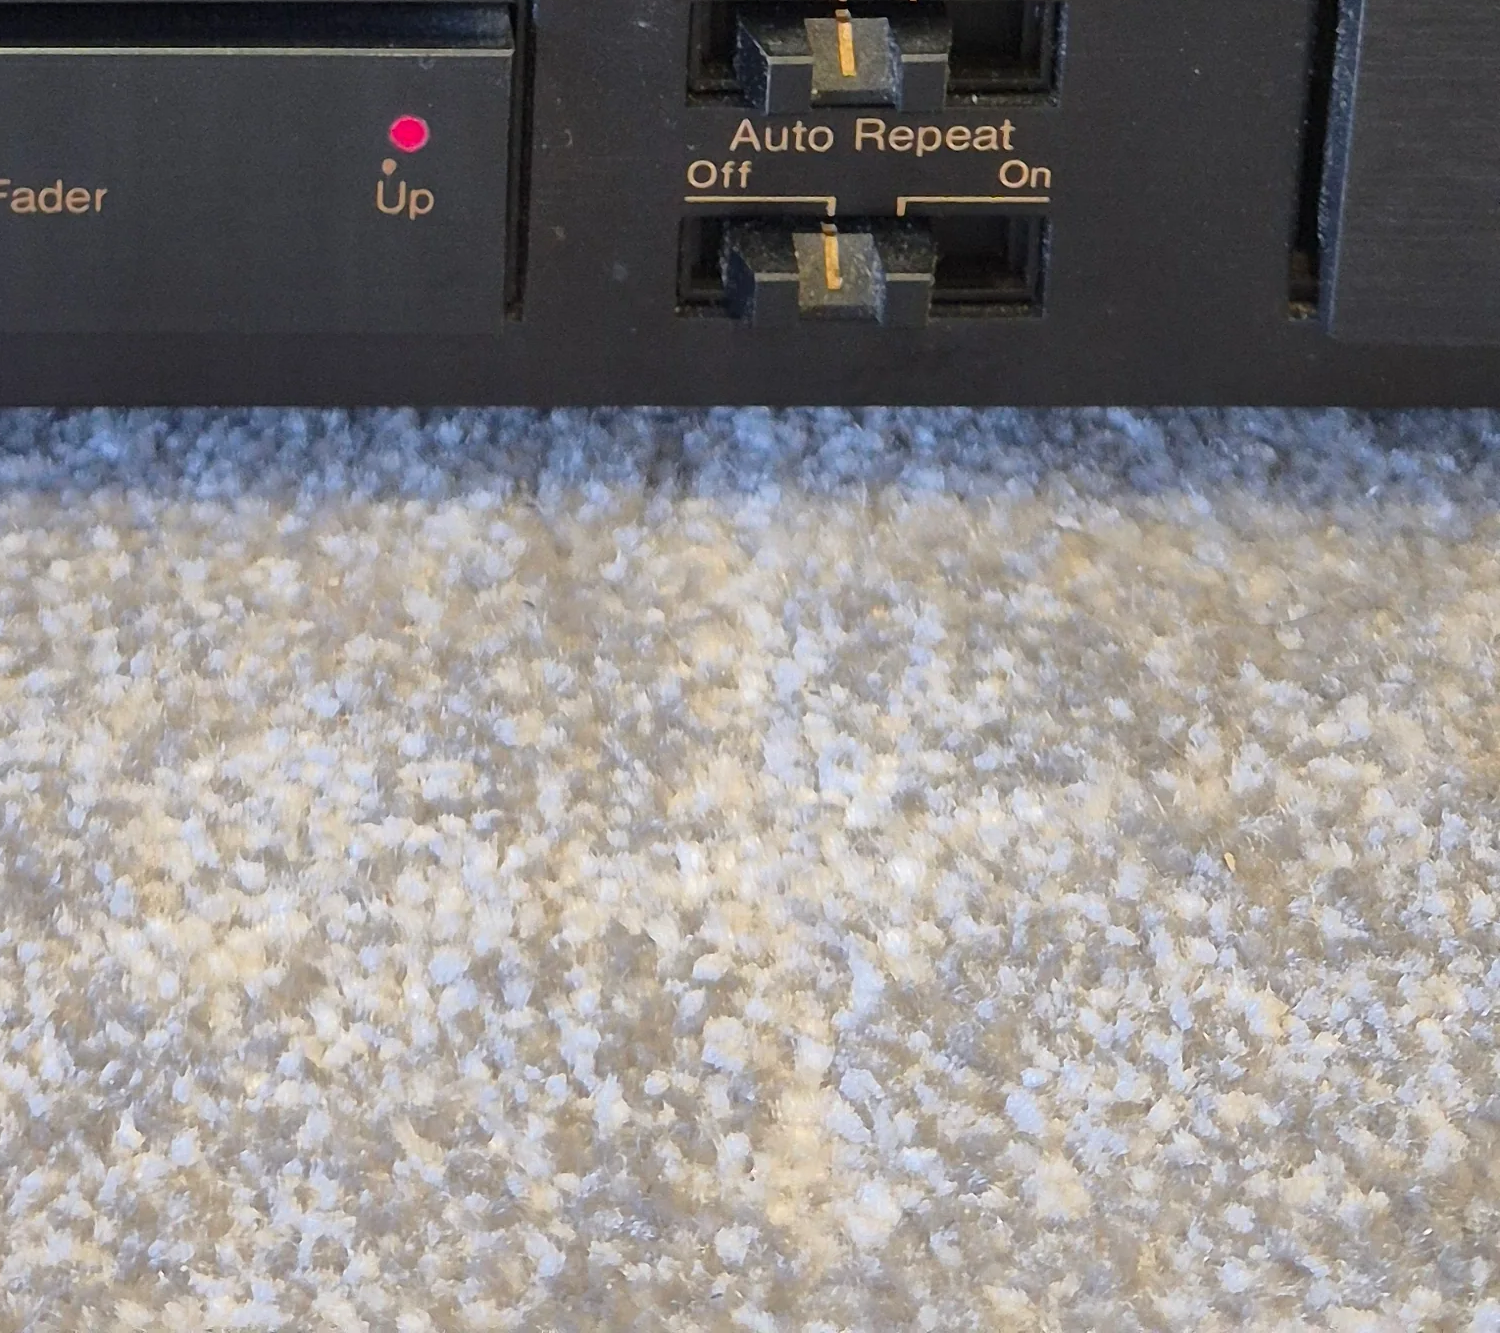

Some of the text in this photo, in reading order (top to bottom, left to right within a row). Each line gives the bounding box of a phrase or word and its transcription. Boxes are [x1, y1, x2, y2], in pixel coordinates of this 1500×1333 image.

[729, 117, 1016, 157] Auto Repeat
[686, 160, 753, 189] Off
[999, 159, 1051, 189] On
[375, 181, 435, 219] Up
